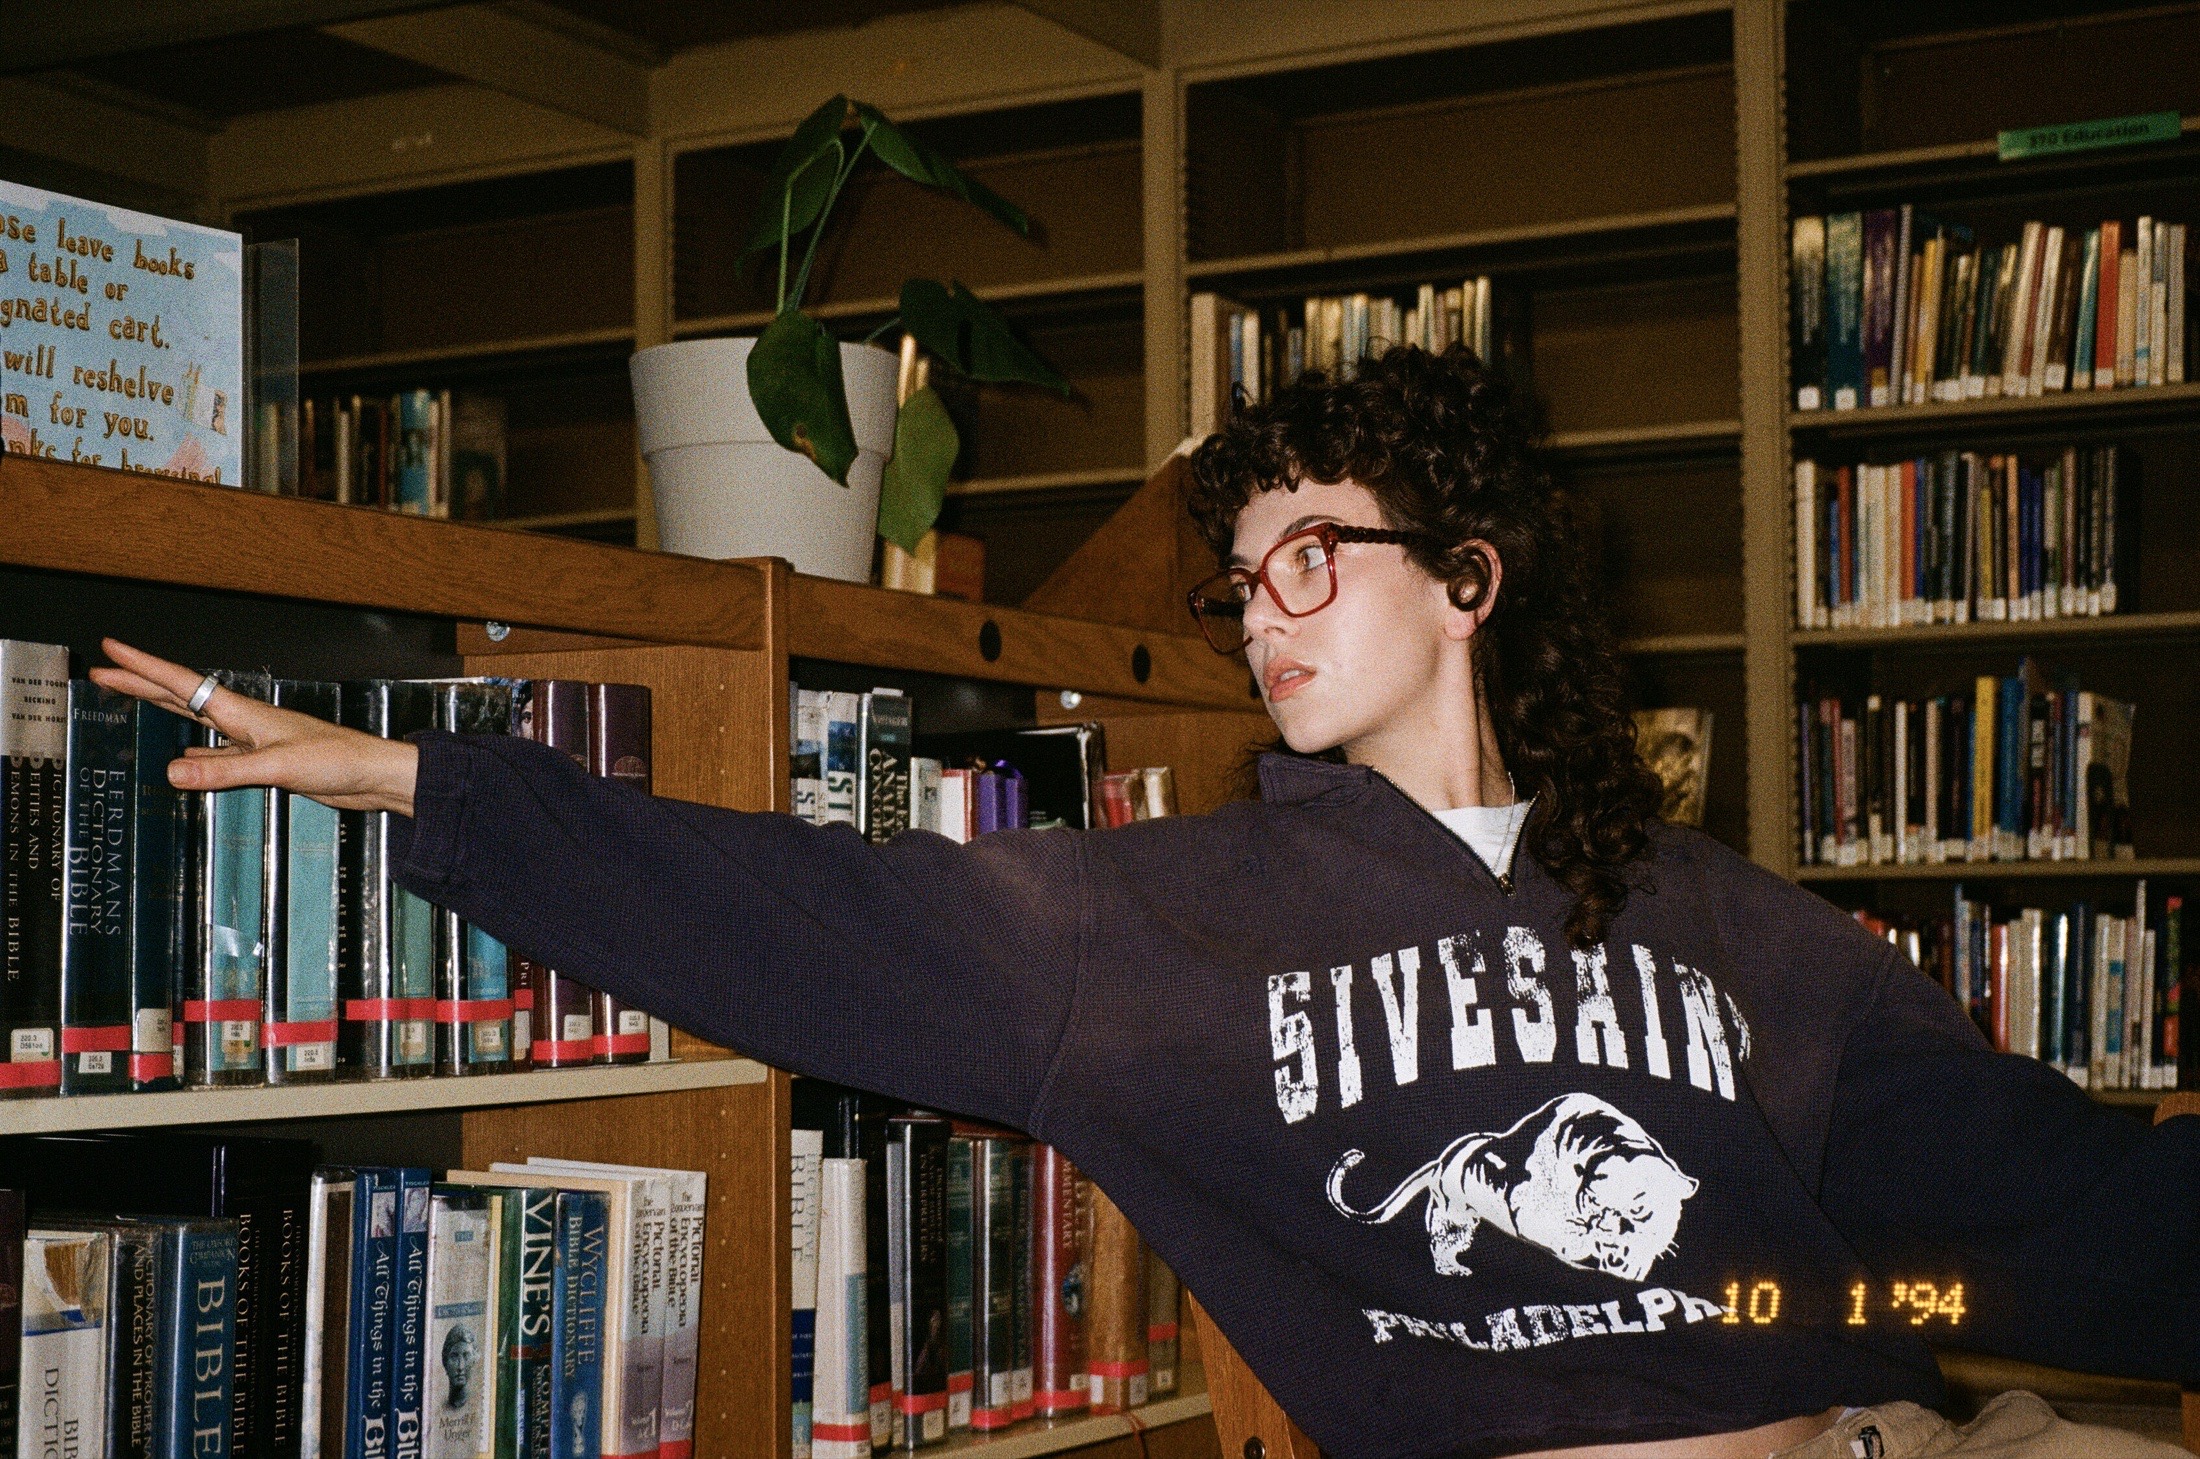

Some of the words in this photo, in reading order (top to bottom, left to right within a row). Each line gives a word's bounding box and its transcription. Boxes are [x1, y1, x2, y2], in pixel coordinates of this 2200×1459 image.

[2062, 122, 2150, 143] Education
[58, 217, 113, 262] leave
[134, 239, 195, 280] books
[29, 252, 88, 294] table
[105, 282, 128, 301] or
[0, 297, 91, 331] gnated
[109, 315, 170, 349] cart.
[3, 344, 56, 378] will
[73, 359, 174, 405] reshelve
[5, 393, 29, 417] m
[50, 391, 87, 428] for
[103, 411, 154, 441] you.
[12, 677, 25, 685] VAN
[28, 679, 42, 687] DER
[24, 696, 56, 705] BECKING
[28, 714, 42, 722] DER
[74, 708, 127, 724] FREEDMAN
[79, 766, 91, 792] OF
[78, 802, 91, 838] THE
[9, 842, 20, 861] IN
[28, 833, 40, 870] AND
[90, 768, 107, 935] DICTIONARY
[105, 769, 126, 936] EERDMANS
[8, 869, 19, 907] THE
[51, 877, 60, 901] OF
[68, 846, 90, 936] BIBLE
[7, 916, 21, 982] BIBLE
[669, 1217, 679, 1239] of
[1062, 1159, 1074, 1249] MMENTARY
[133, 1244, 145, 1281] AND
[237, 1213, 252, 1292] BOOKS
[280, 1209, 293, 1286] BOOKS
[375, 1240, 391, 1278] All
[407, 1236, 424, 1272] All
[522, 1192, 553, 1336] VINE'S
[567, 1215, 583, 1269] BIBLE
[652, 1221, 666, 1291] Pictorial
[667, 1243, 679, 1266] the
[690, 1216, 705, 1285] Pictorial
[577, 1224, 604, 1365] WYCLIFFE
[639, 1221, 653, 1335] Encyclopedia
[667, 1267, 679, 1308] Bible
[678, 1216, 691, 1328] Encyclopedia
[132, 1285, 144, 1345] PLACES
[236, 1297, 250, 1330] OF
[278, 1291, 291, 1322] OF
[369, 1281, 390, 1351] Things
[402, 1275, 423, 1345] Things
[564, 1275, 580, 1379] DICTIONARY
[132, 1349, 144, 1367] IN
[145, 1344, 155, 1365] OF
[193, 1275, 226, 1459] BIBLE
[234, 1334, 249, 1384] THE
[276, 1327, 290, 1376] THE
[371, 1356, 387, 1374] in
[403, 1349, 419, 1368] in
[131, 1371, 143, 1402] THE
[143, 1370, 155, 1433] PROPER
[367, 1379, 387, 1409] the
[400, 1374, 420, 1401] the
[131, 1405, 142, 1448] BIBLE
[232, 1391, 248, 1456] BIBLE
[274, 1384, 288, 1447] BIBLE
